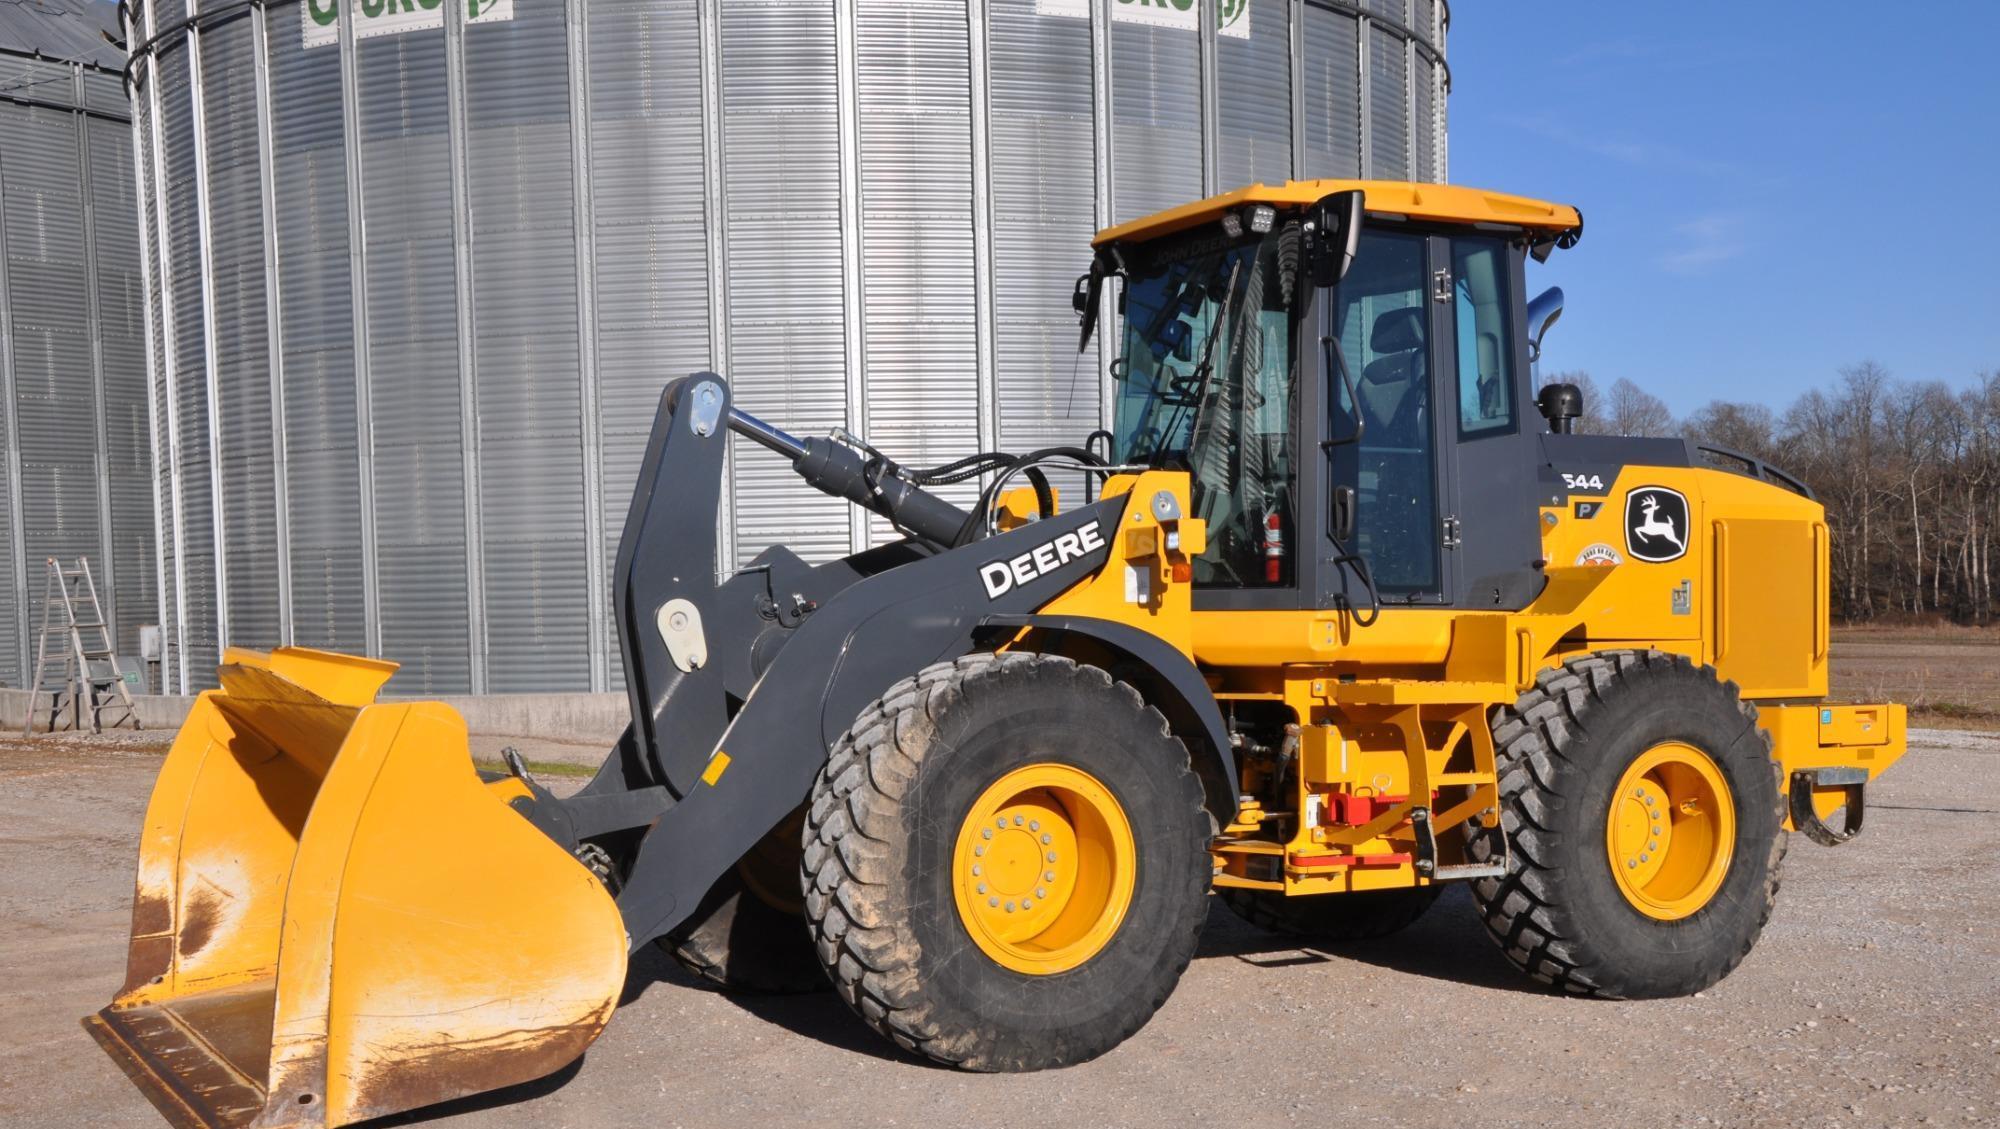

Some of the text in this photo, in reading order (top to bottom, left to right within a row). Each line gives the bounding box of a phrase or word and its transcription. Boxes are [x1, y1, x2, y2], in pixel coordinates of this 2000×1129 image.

[1561, 473, 1604, 490] 544
[1579, 503, 1592, 518] P
[980, 521, 1106, 600] DEERE
